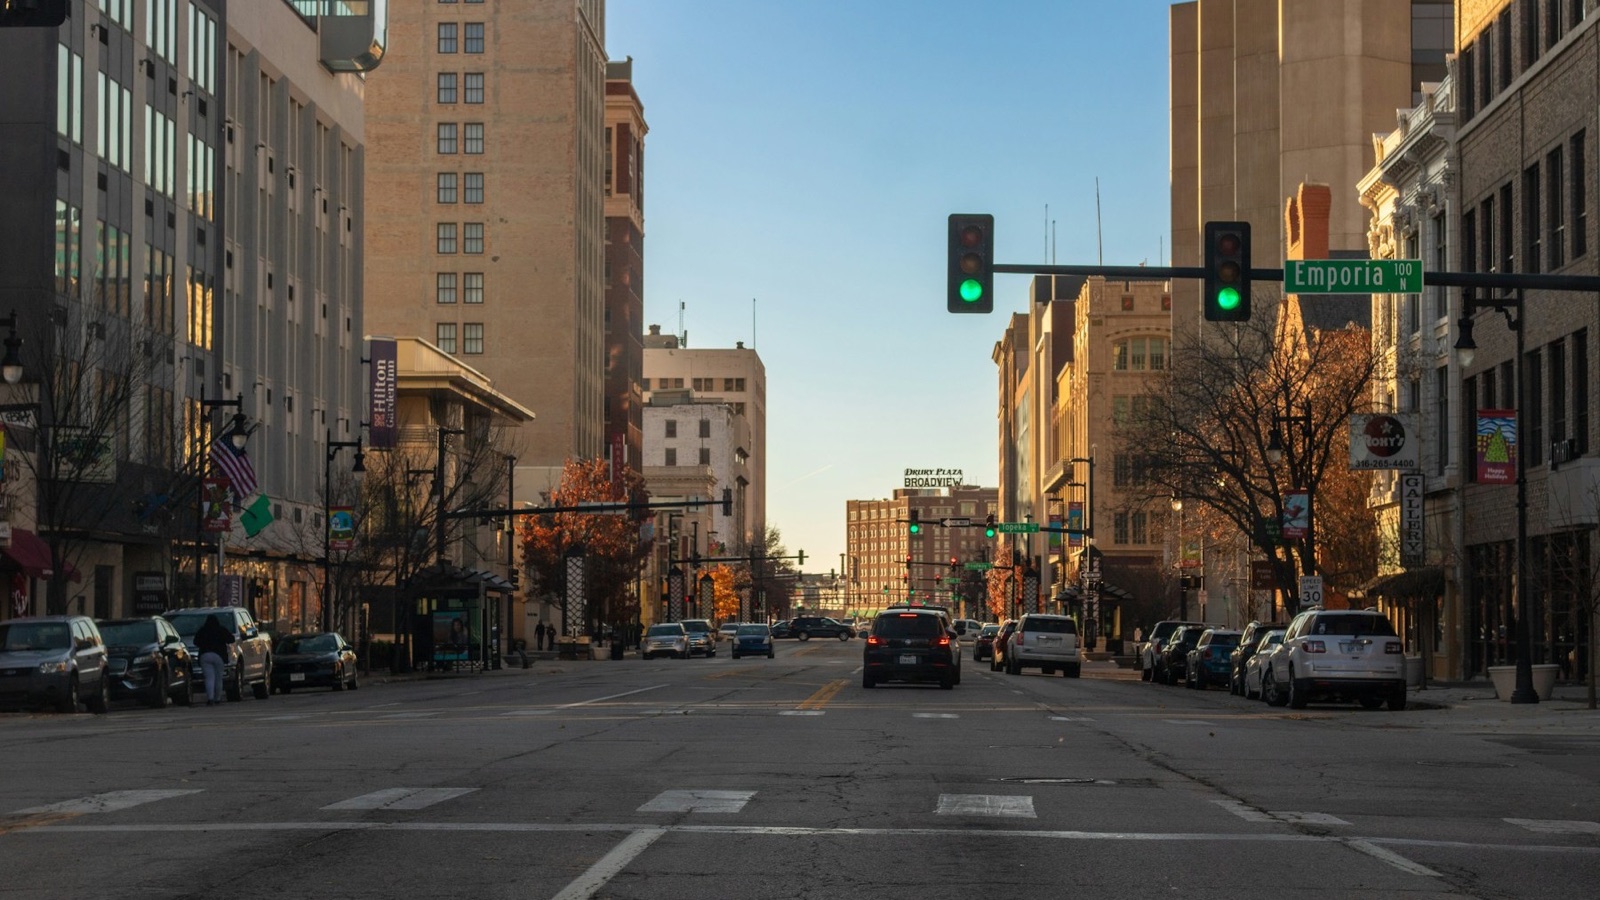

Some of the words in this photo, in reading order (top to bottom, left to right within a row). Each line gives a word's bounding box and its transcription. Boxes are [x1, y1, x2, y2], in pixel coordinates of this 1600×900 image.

[1394, 263, 1412, 276] 100
[1295, 261, 1383, 292] Emporia
[1400, 277, 1407, 291] N
[386, 360, 394, 382] Inn
[374, 359, 386, 412] Hilton
[386, 384, 394, 428] Garden
[1355, 459, 1414, 468] 316-265-4400
[1487, 467, 1505, 475] Happy
[904, 477, 963, 487] BROADVIEW
[1405, 477, 1421, 551] GALLERY
[1002, 524, 1027, 532] Topeka
[1303, 591, 1321, 602] 30
